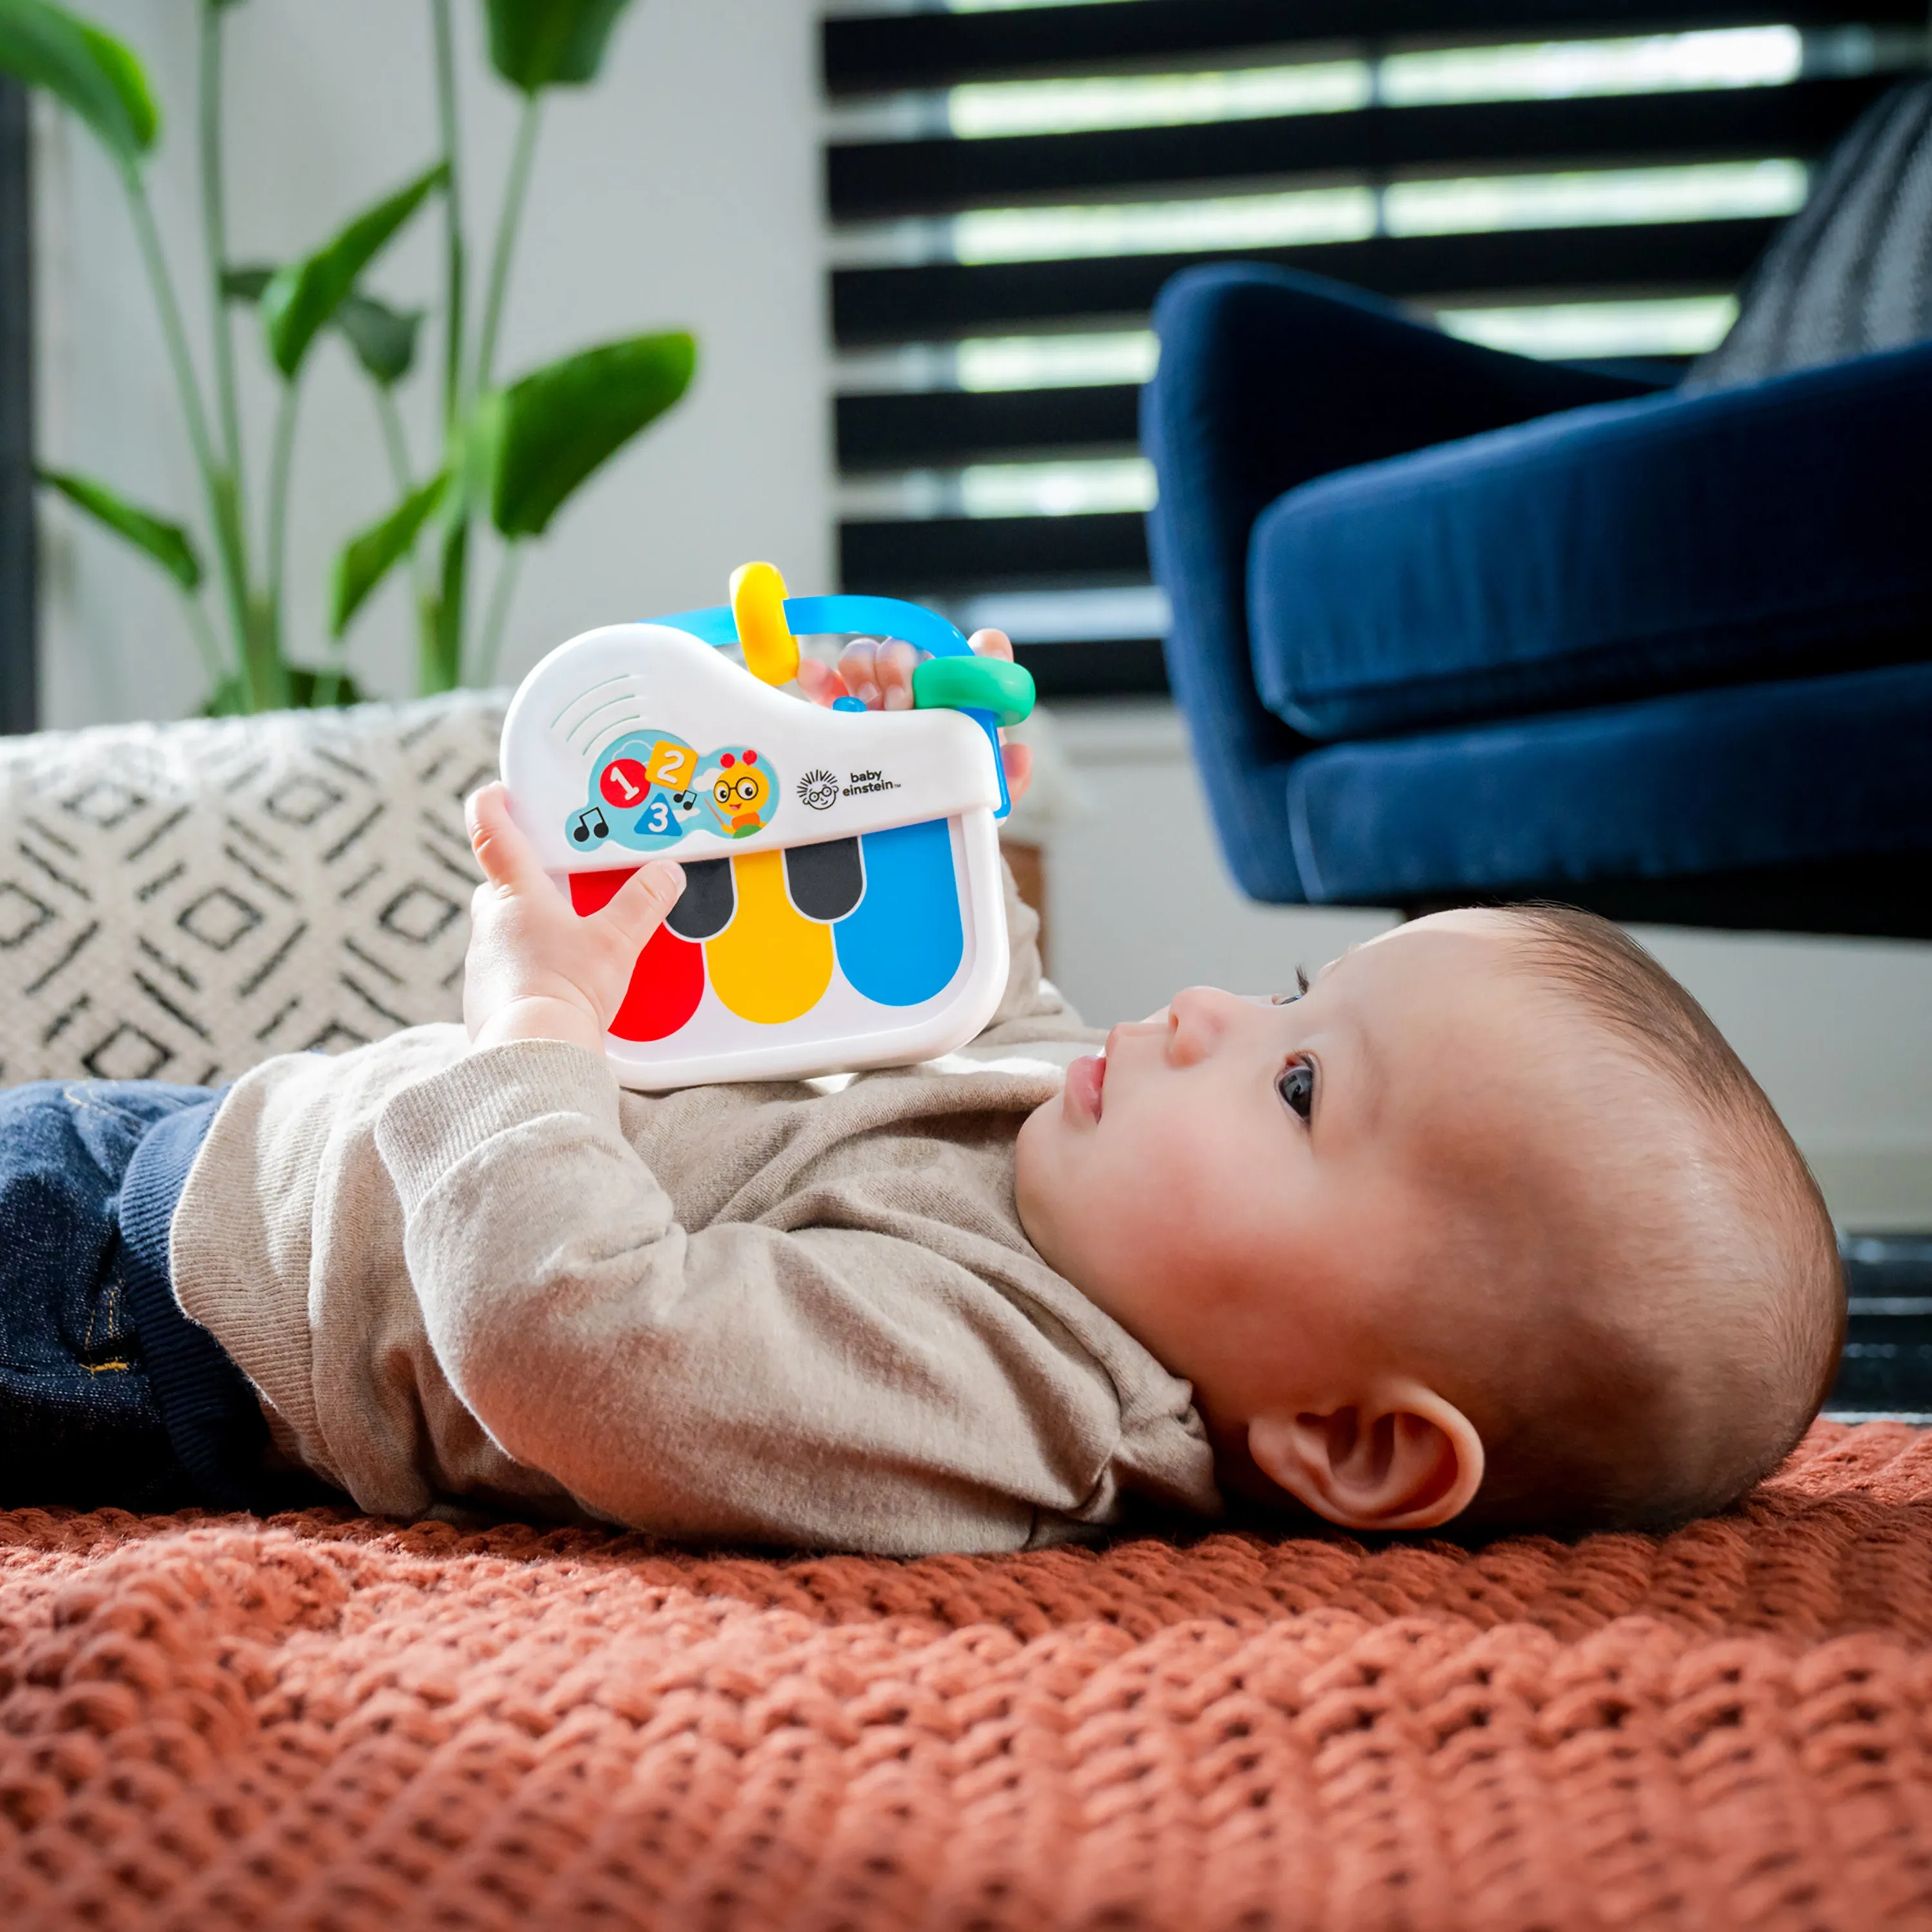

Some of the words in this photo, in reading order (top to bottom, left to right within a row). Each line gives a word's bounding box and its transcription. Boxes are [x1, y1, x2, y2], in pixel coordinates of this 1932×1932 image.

[610, 766, 640, 800] 1
[657, 750, 685, 784] 2
[850, 770, 882, 783] baby
[648, 802, 668, 832] 3
